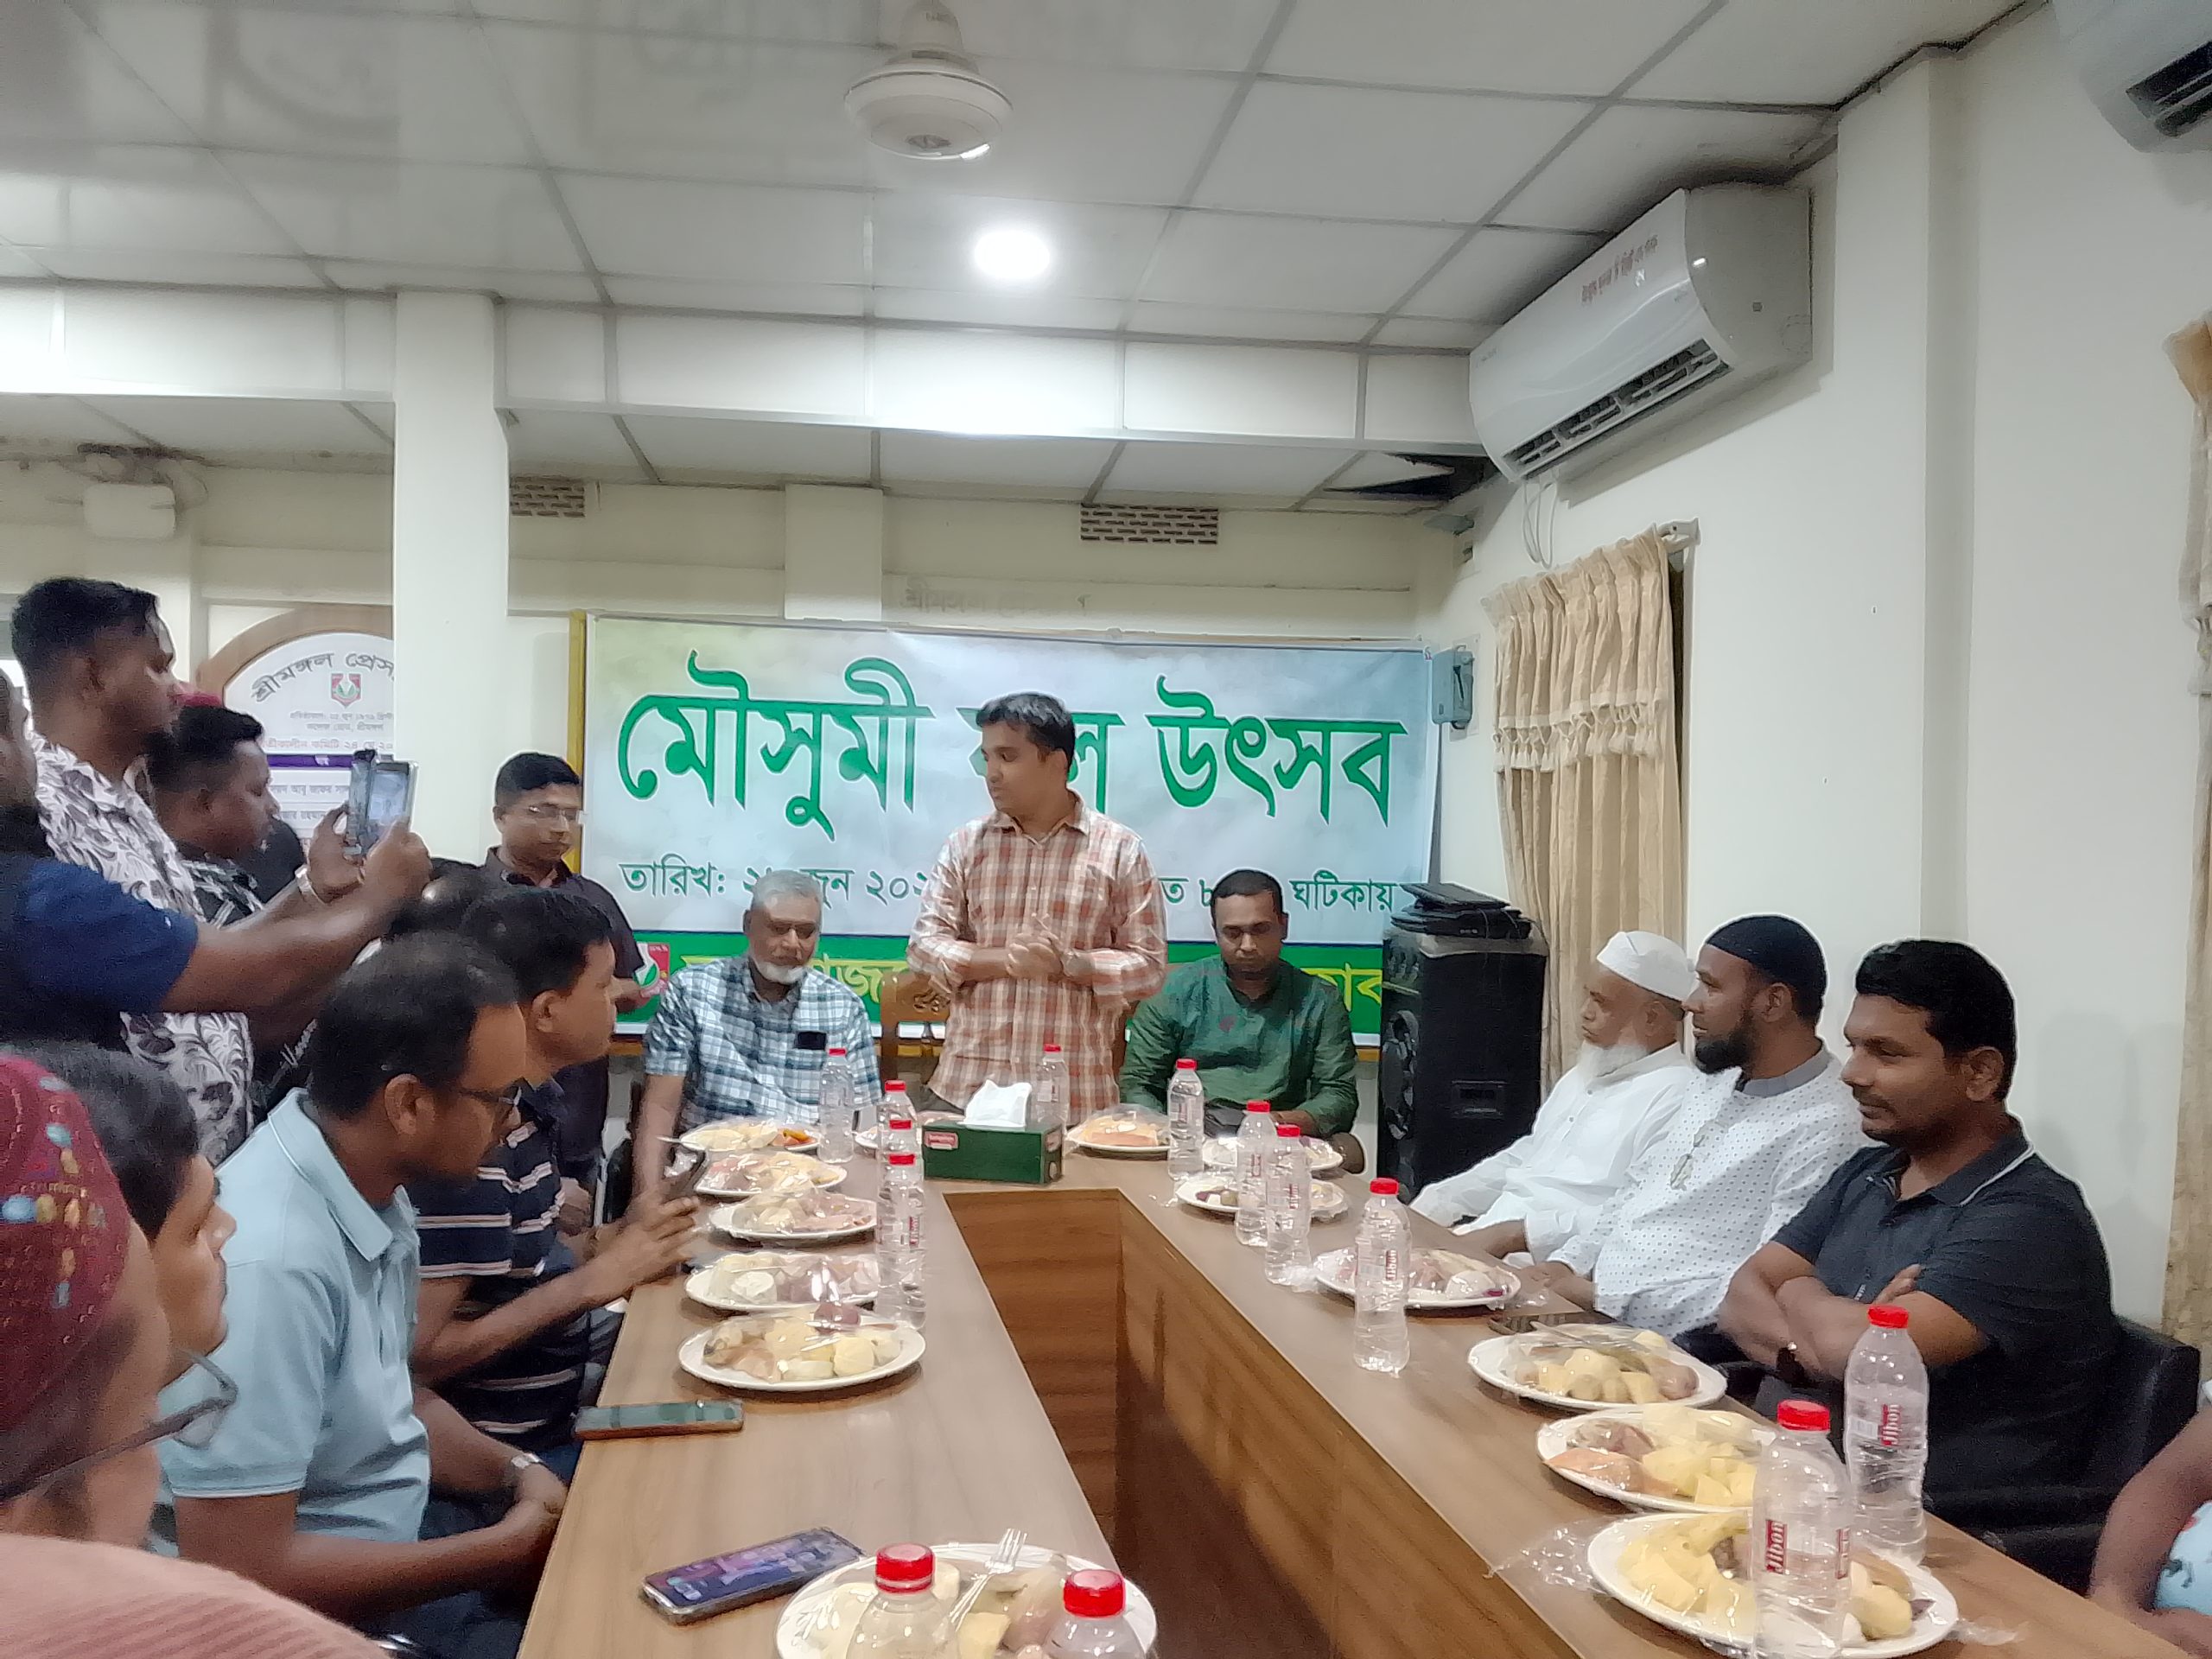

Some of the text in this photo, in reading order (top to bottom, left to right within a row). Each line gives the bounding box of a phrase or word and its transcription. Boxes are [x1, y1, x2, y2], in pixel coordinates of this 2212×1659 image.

[346, 652, 395, 682] প্রেস
[618, 649, 936, 842] মৌসুমী
[1144, 673, 1408, 828] উৎসব
[1288, 869, 1398, 912] ঘটিকায়
